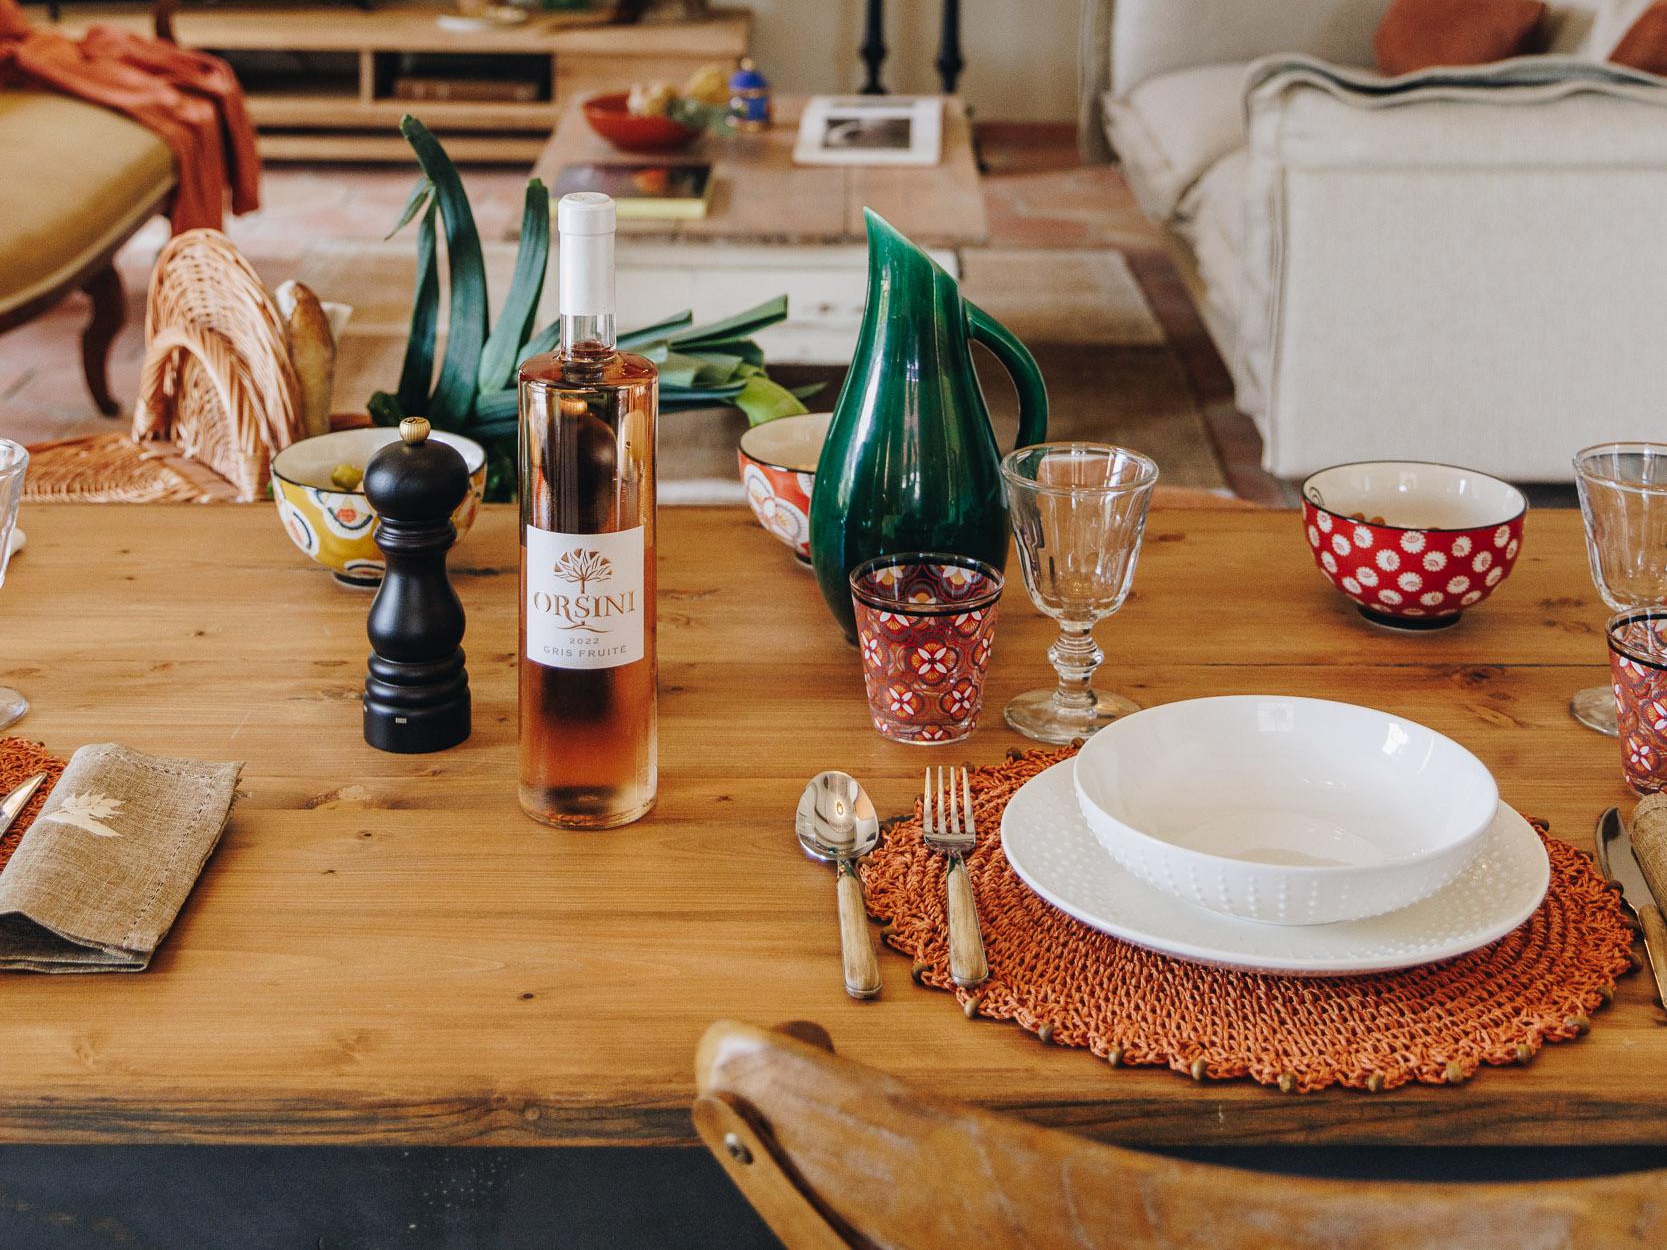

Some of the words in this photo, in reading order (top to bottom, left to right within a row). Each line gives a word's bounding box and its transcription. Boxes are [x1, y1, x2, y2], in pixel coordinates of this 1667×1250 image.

[533, 589, 636, 622] ORSINI
[569, 637, 600, 645] 2022
[543, 646, 574, 657] GRIS
